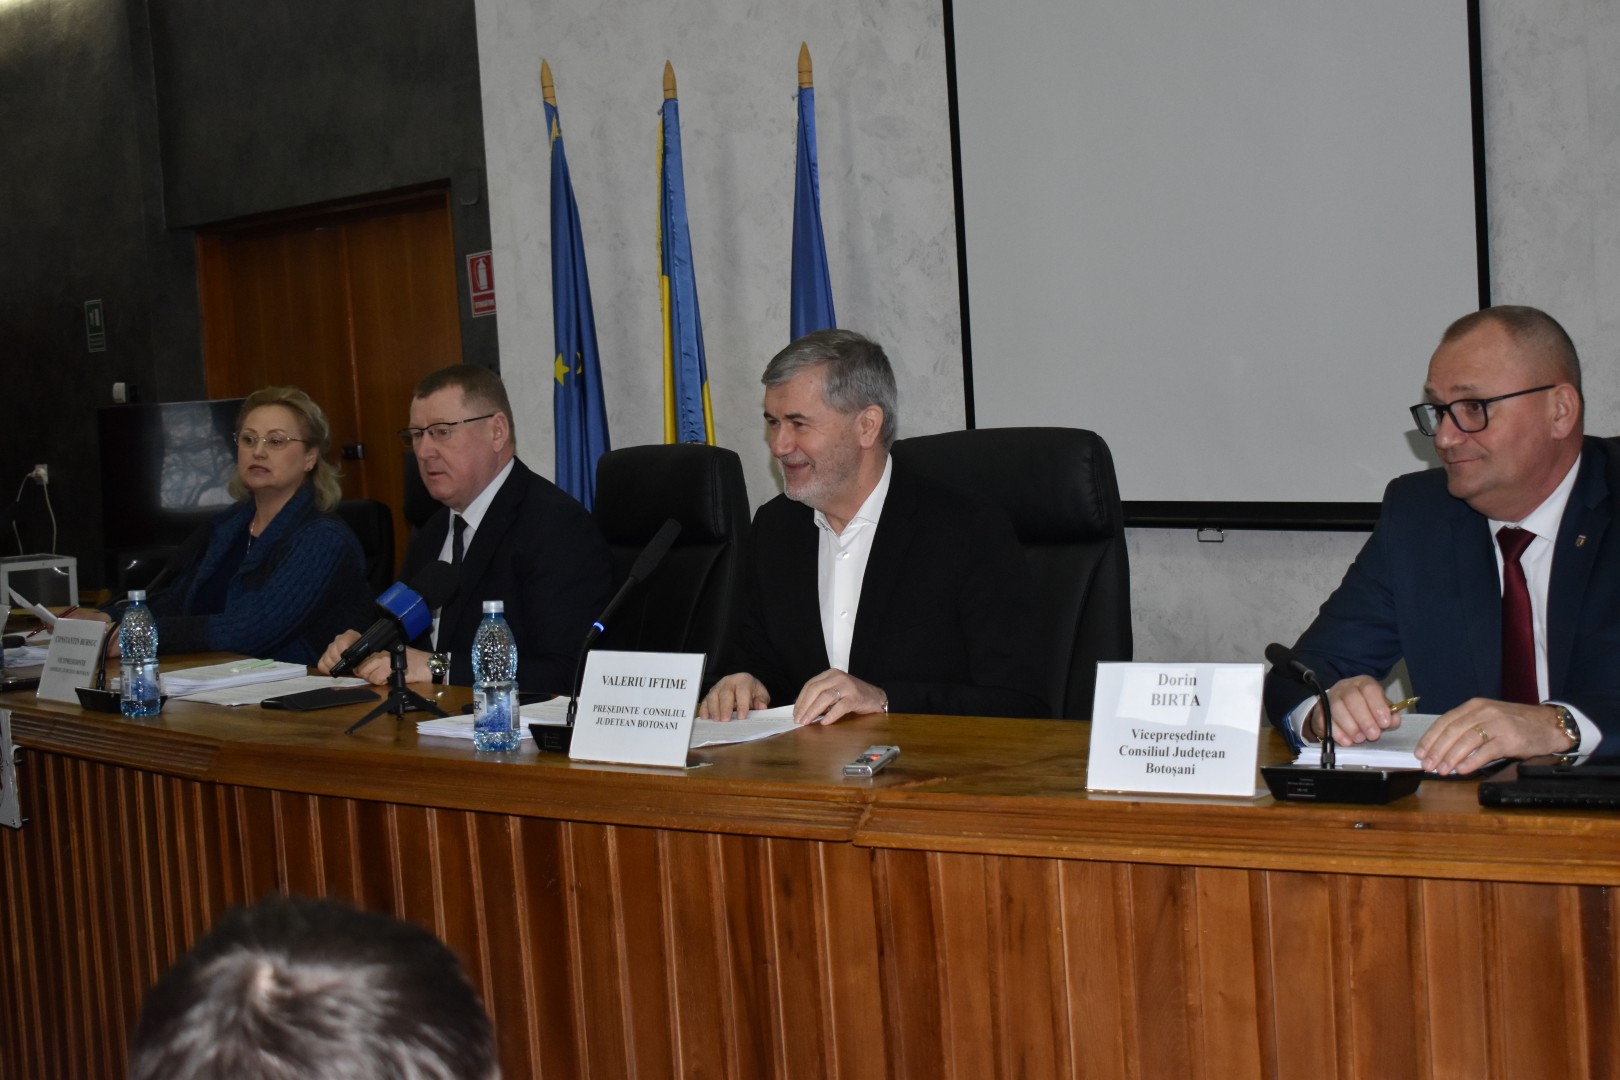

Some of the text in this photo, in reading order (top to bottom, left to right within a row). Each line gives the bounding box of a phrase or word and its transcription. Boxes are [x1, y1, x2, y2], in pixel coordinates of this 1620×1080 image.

[602, 675, 687, 690] VALERIU IFTIME
[1158, 673, 1197, 686] Dorin
[1150, 693, 1201, 707] BIRTA
[643, 707, 687, 718] CONSILIUL
[595, 717, 678, 730] JUDETEAN BOTOSANI
[1132, 728, 1216, 743] Vicepreședinte
[1119, 745, 1226, 760] Consiliul Județean
[1145, 762, 1196, 776] Botoșani
